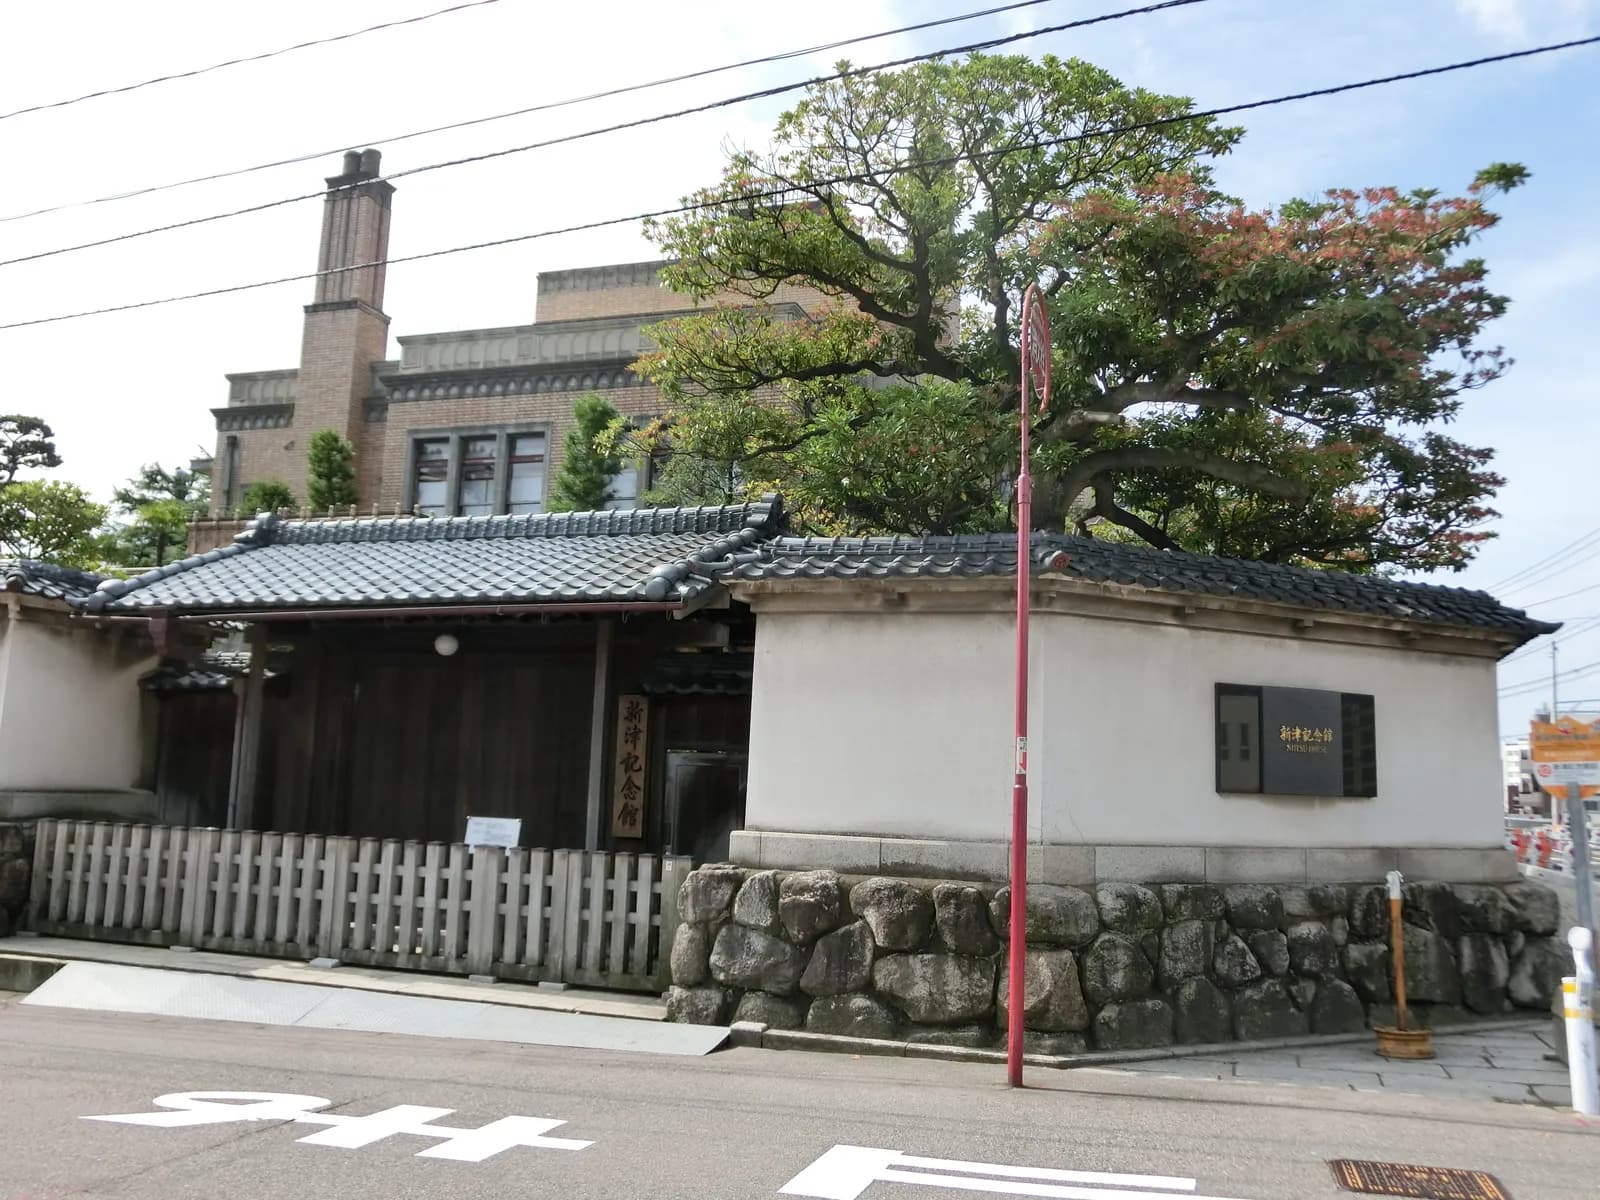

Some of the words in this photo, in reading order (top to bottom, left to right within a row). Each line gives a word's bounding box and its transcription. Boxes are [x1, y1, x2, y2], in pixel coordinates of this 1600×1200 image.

[617, 700, 645, 828] 新津記念館
[1280, 725, 1334, 742] 新津記念館
